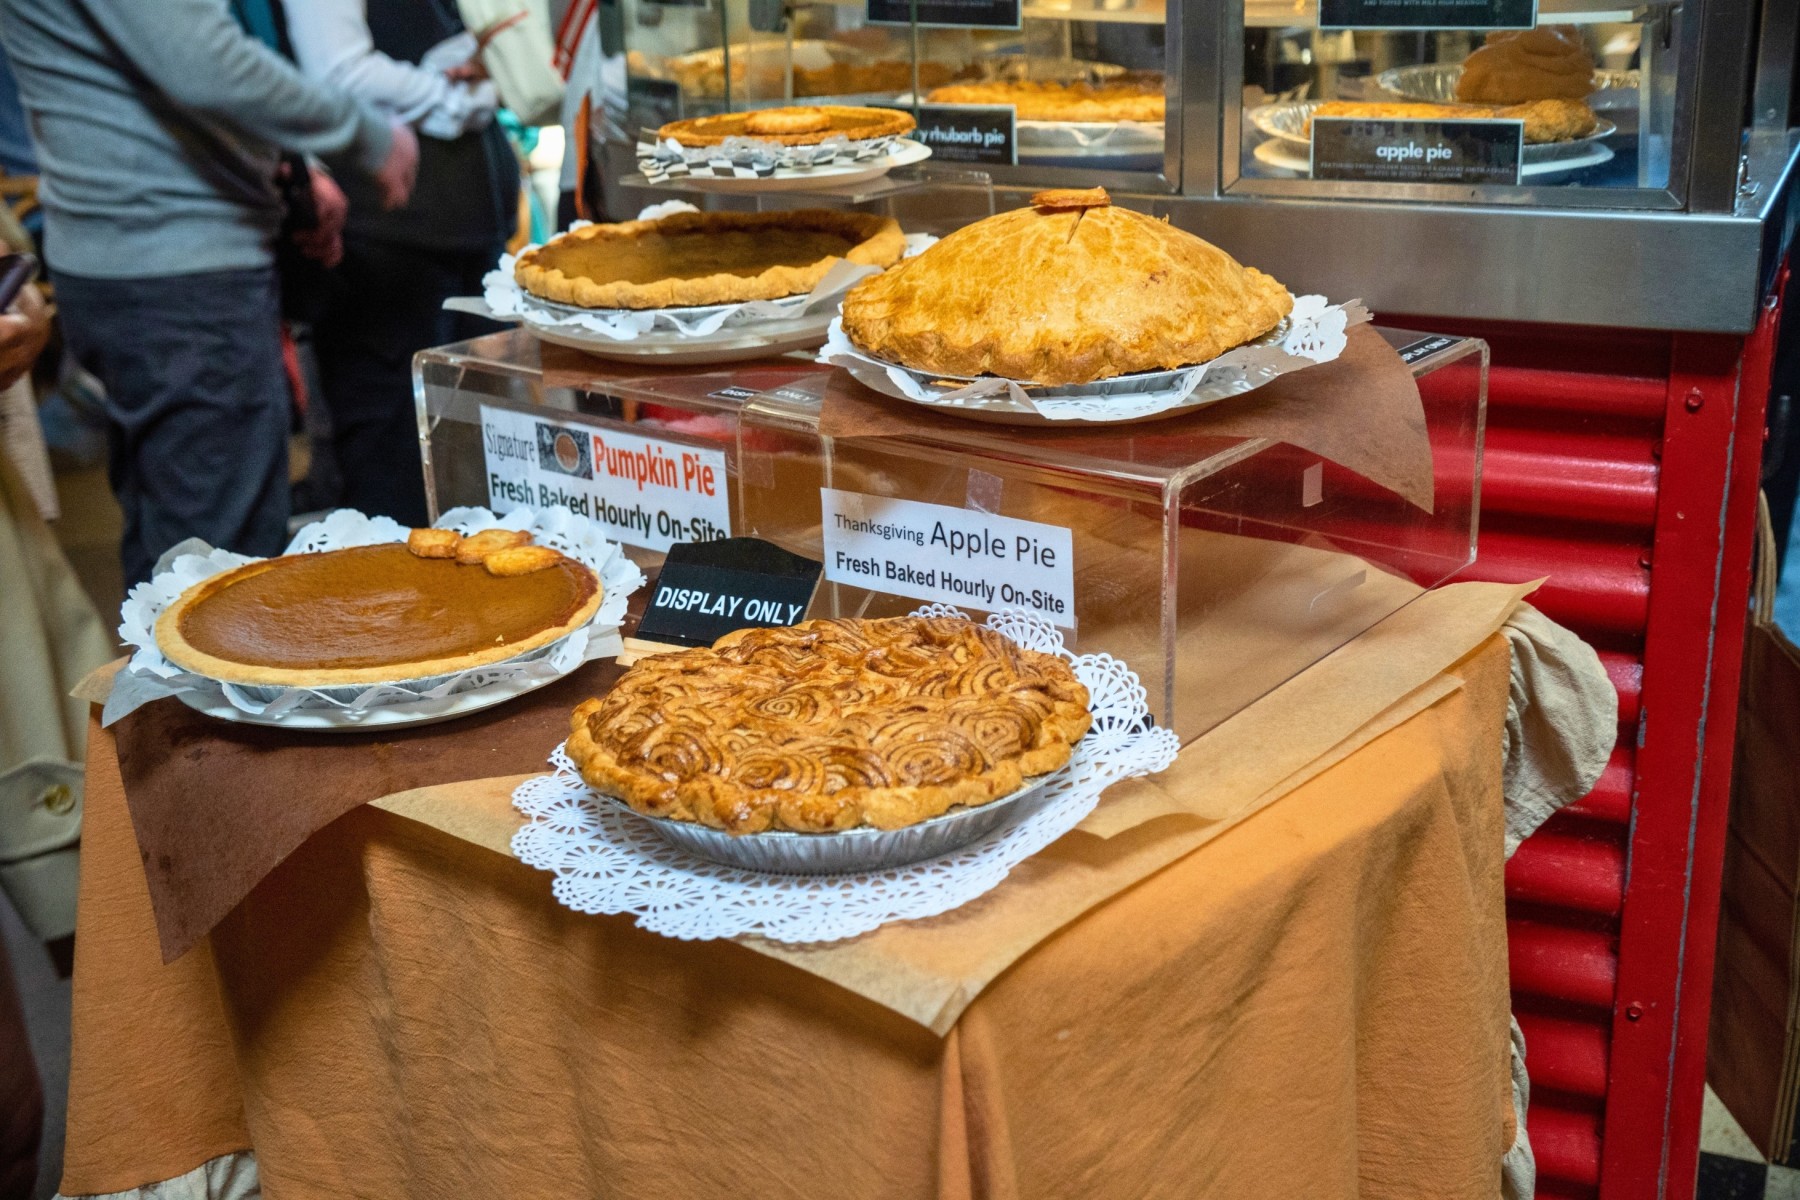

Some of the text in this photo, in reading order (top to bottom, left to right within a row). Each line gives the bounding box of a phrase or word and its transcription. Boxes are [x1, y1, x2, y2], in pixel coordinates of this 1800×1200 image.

[929, 125, 983, 143] rhubarb
[984, 127, 1006, 148] pie
[1376, 141, 1453, 163] apple pie
[485, 423, 715, 496] Signature Pumpkin Pie
[490, 473, 534, 506] Fresh
[594, 496, 651, 539] Hourly
[834, 513, 1056, 568] Thanksgiving Apple Pie
[655, 586, 803, 626] DISPLAY ONLY
[836, 551, 1065, 614] Fresh Baked Hourly On-Site
